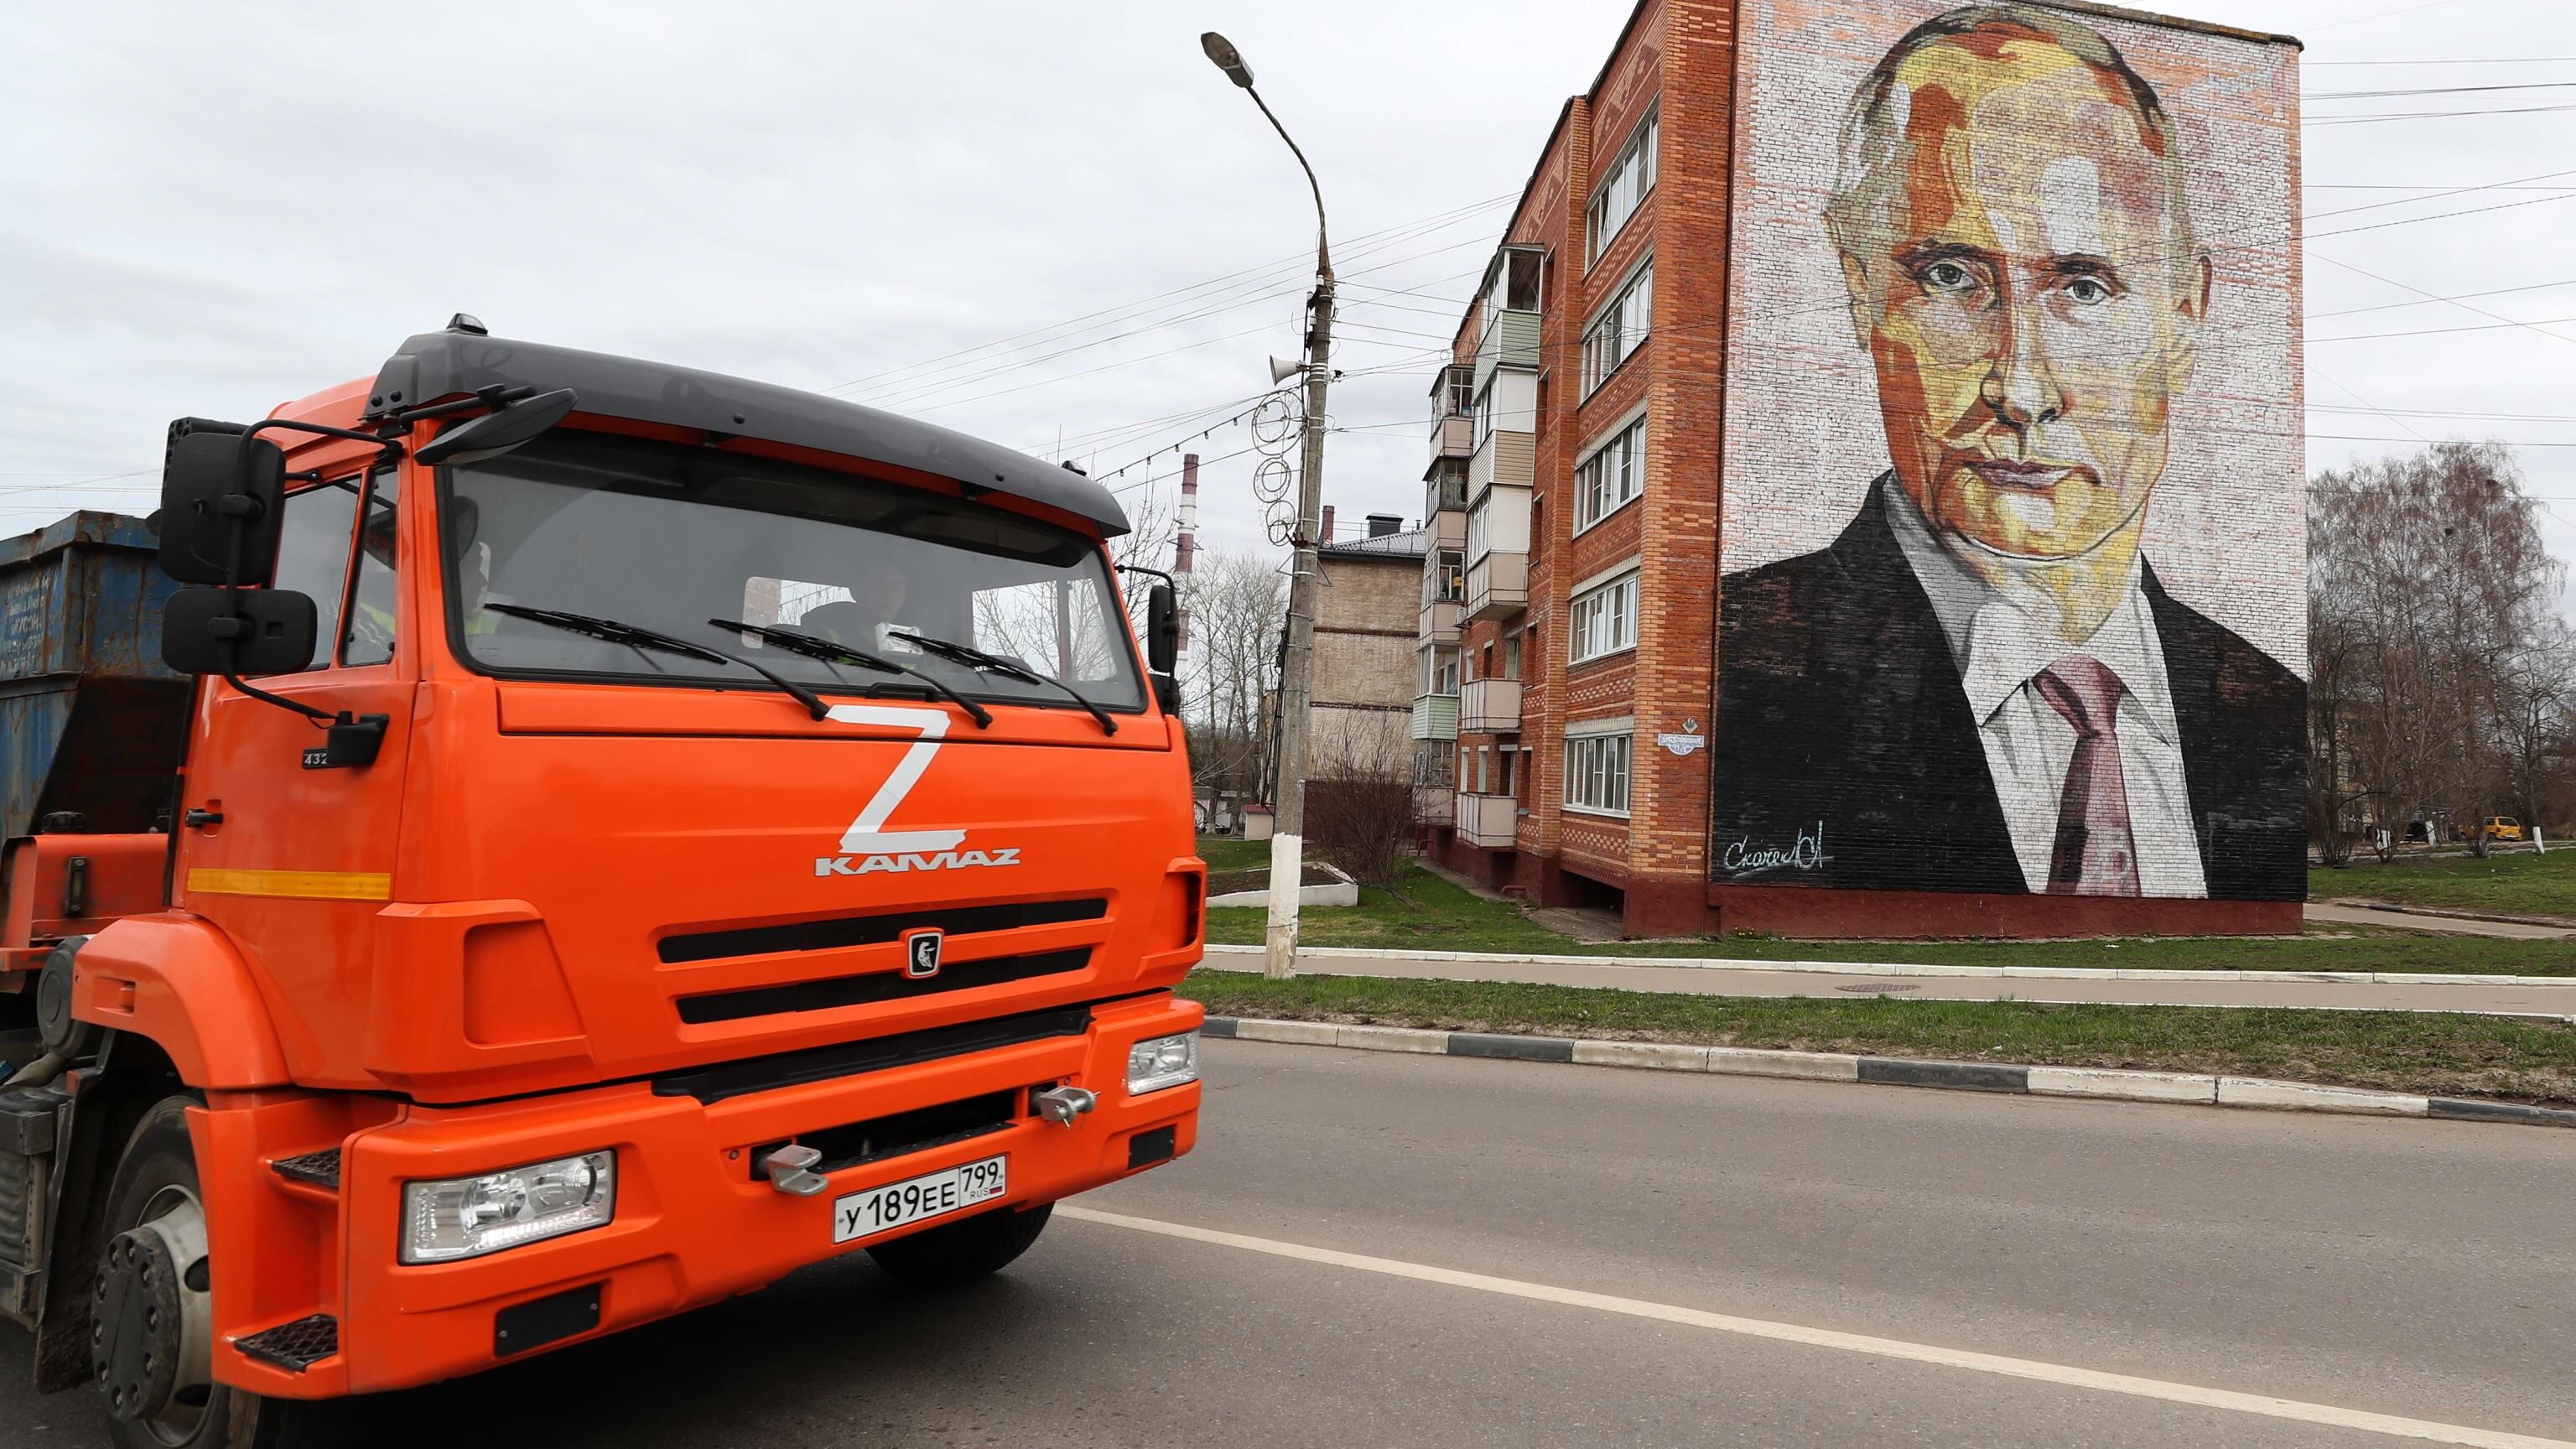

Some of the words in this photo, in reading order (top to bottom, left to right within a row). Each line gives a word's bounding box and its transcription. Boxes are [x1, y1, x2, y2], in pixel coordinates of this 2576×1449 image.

[825, 704, 968, 854] Z
[814, 848, 1021, 877] KAMAZ
[962, 1161, 999, 1193] 799
[970, 1187, 989, 1200] RUS
